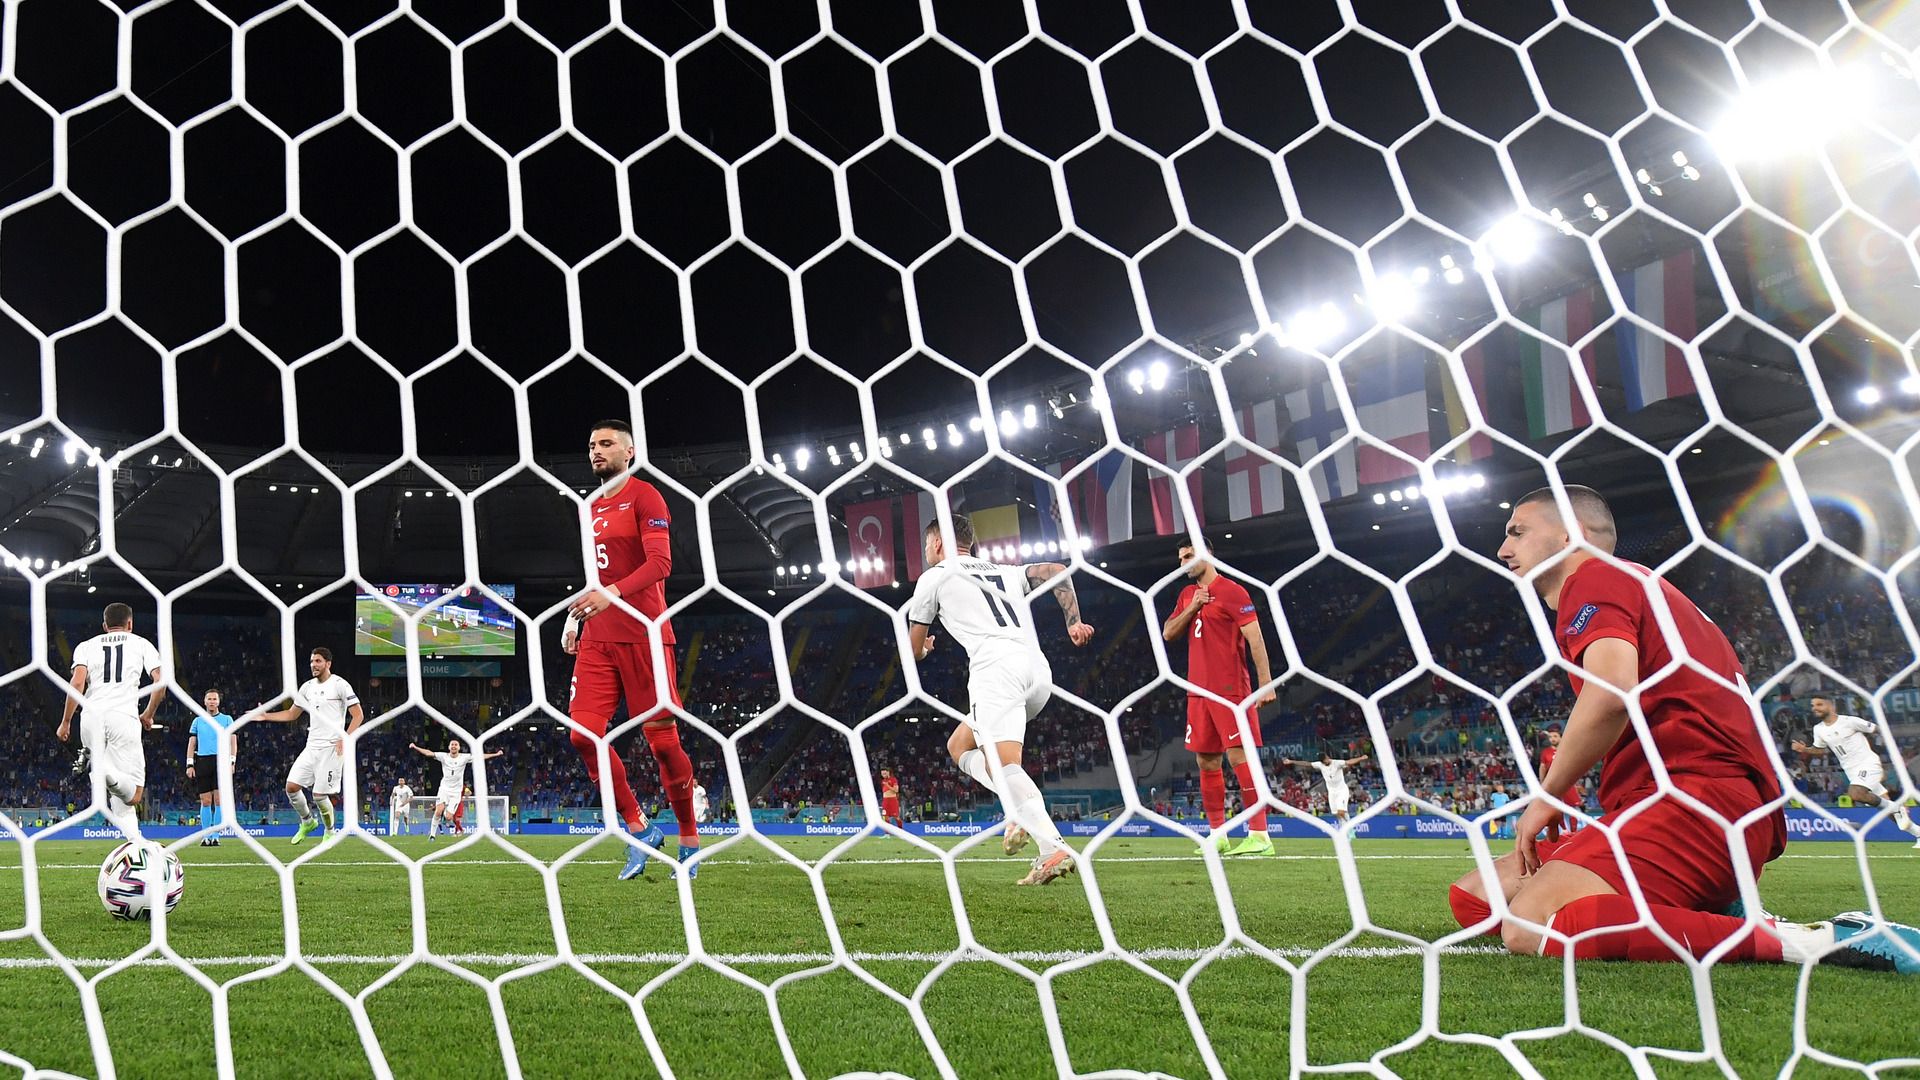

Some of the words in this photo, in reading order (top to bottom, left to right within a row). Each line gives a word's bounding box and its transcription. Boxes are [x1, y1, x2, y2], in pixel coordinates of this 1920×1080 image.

[596, 543, 609, 569] 5
[1194, 618, 1203, 638] 2
[102, 643, 123, 683] 11
[423, 665, 449, 674] ROME
[1184, 724, 1193, 744] 2
[327, 770, 334, 783] 5
[83, 828, 125, 839] Booking.
[806, 825, 862, 835] Booking.com
[924, 824, 982, 835] Booking.com
[1415, 818, 1466, 835] Booking.co
[1784, 814, 1848, 837] ing.com
